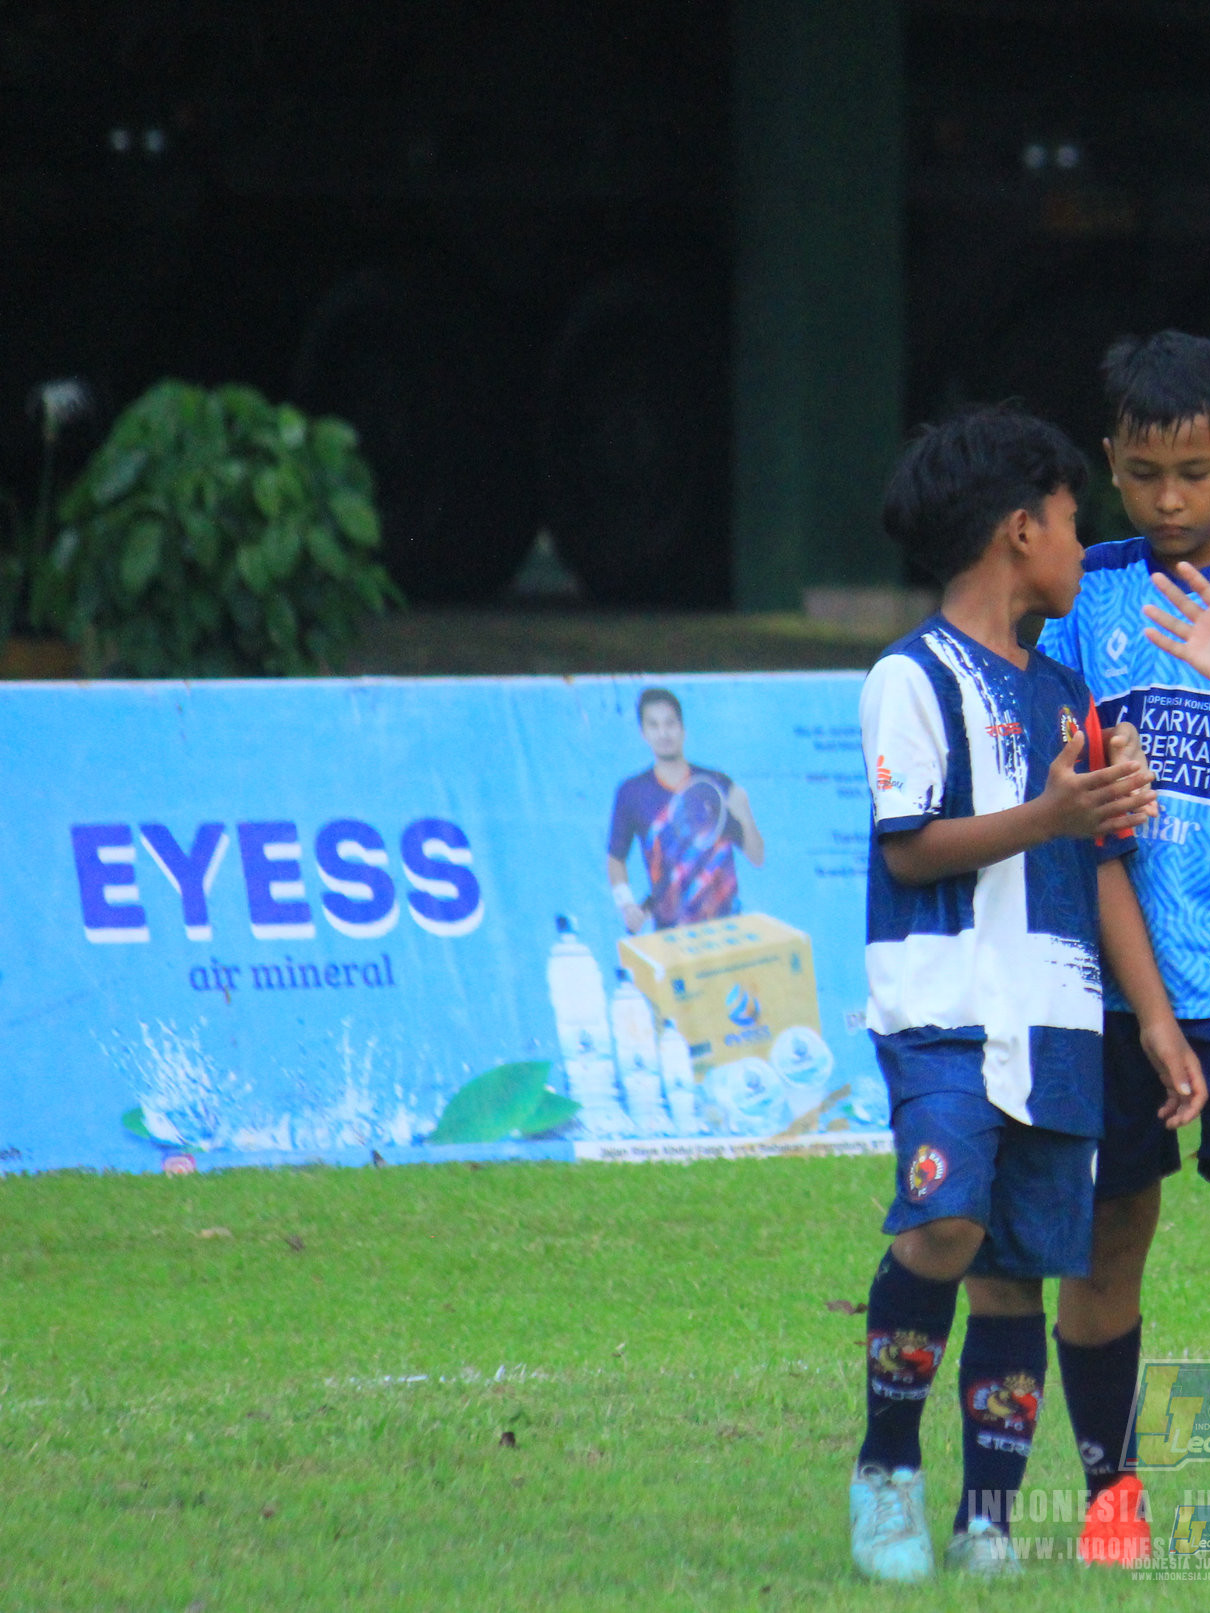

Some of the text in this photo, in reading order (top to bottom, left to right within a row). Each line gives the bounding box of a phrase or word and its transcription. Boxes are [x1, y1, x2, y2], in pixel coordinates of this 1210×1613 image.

[1140, 695, 1210, 738] KARYA
[70, 817, 485, 945] EYESS
[189, 953, 395, 991] air mineral
